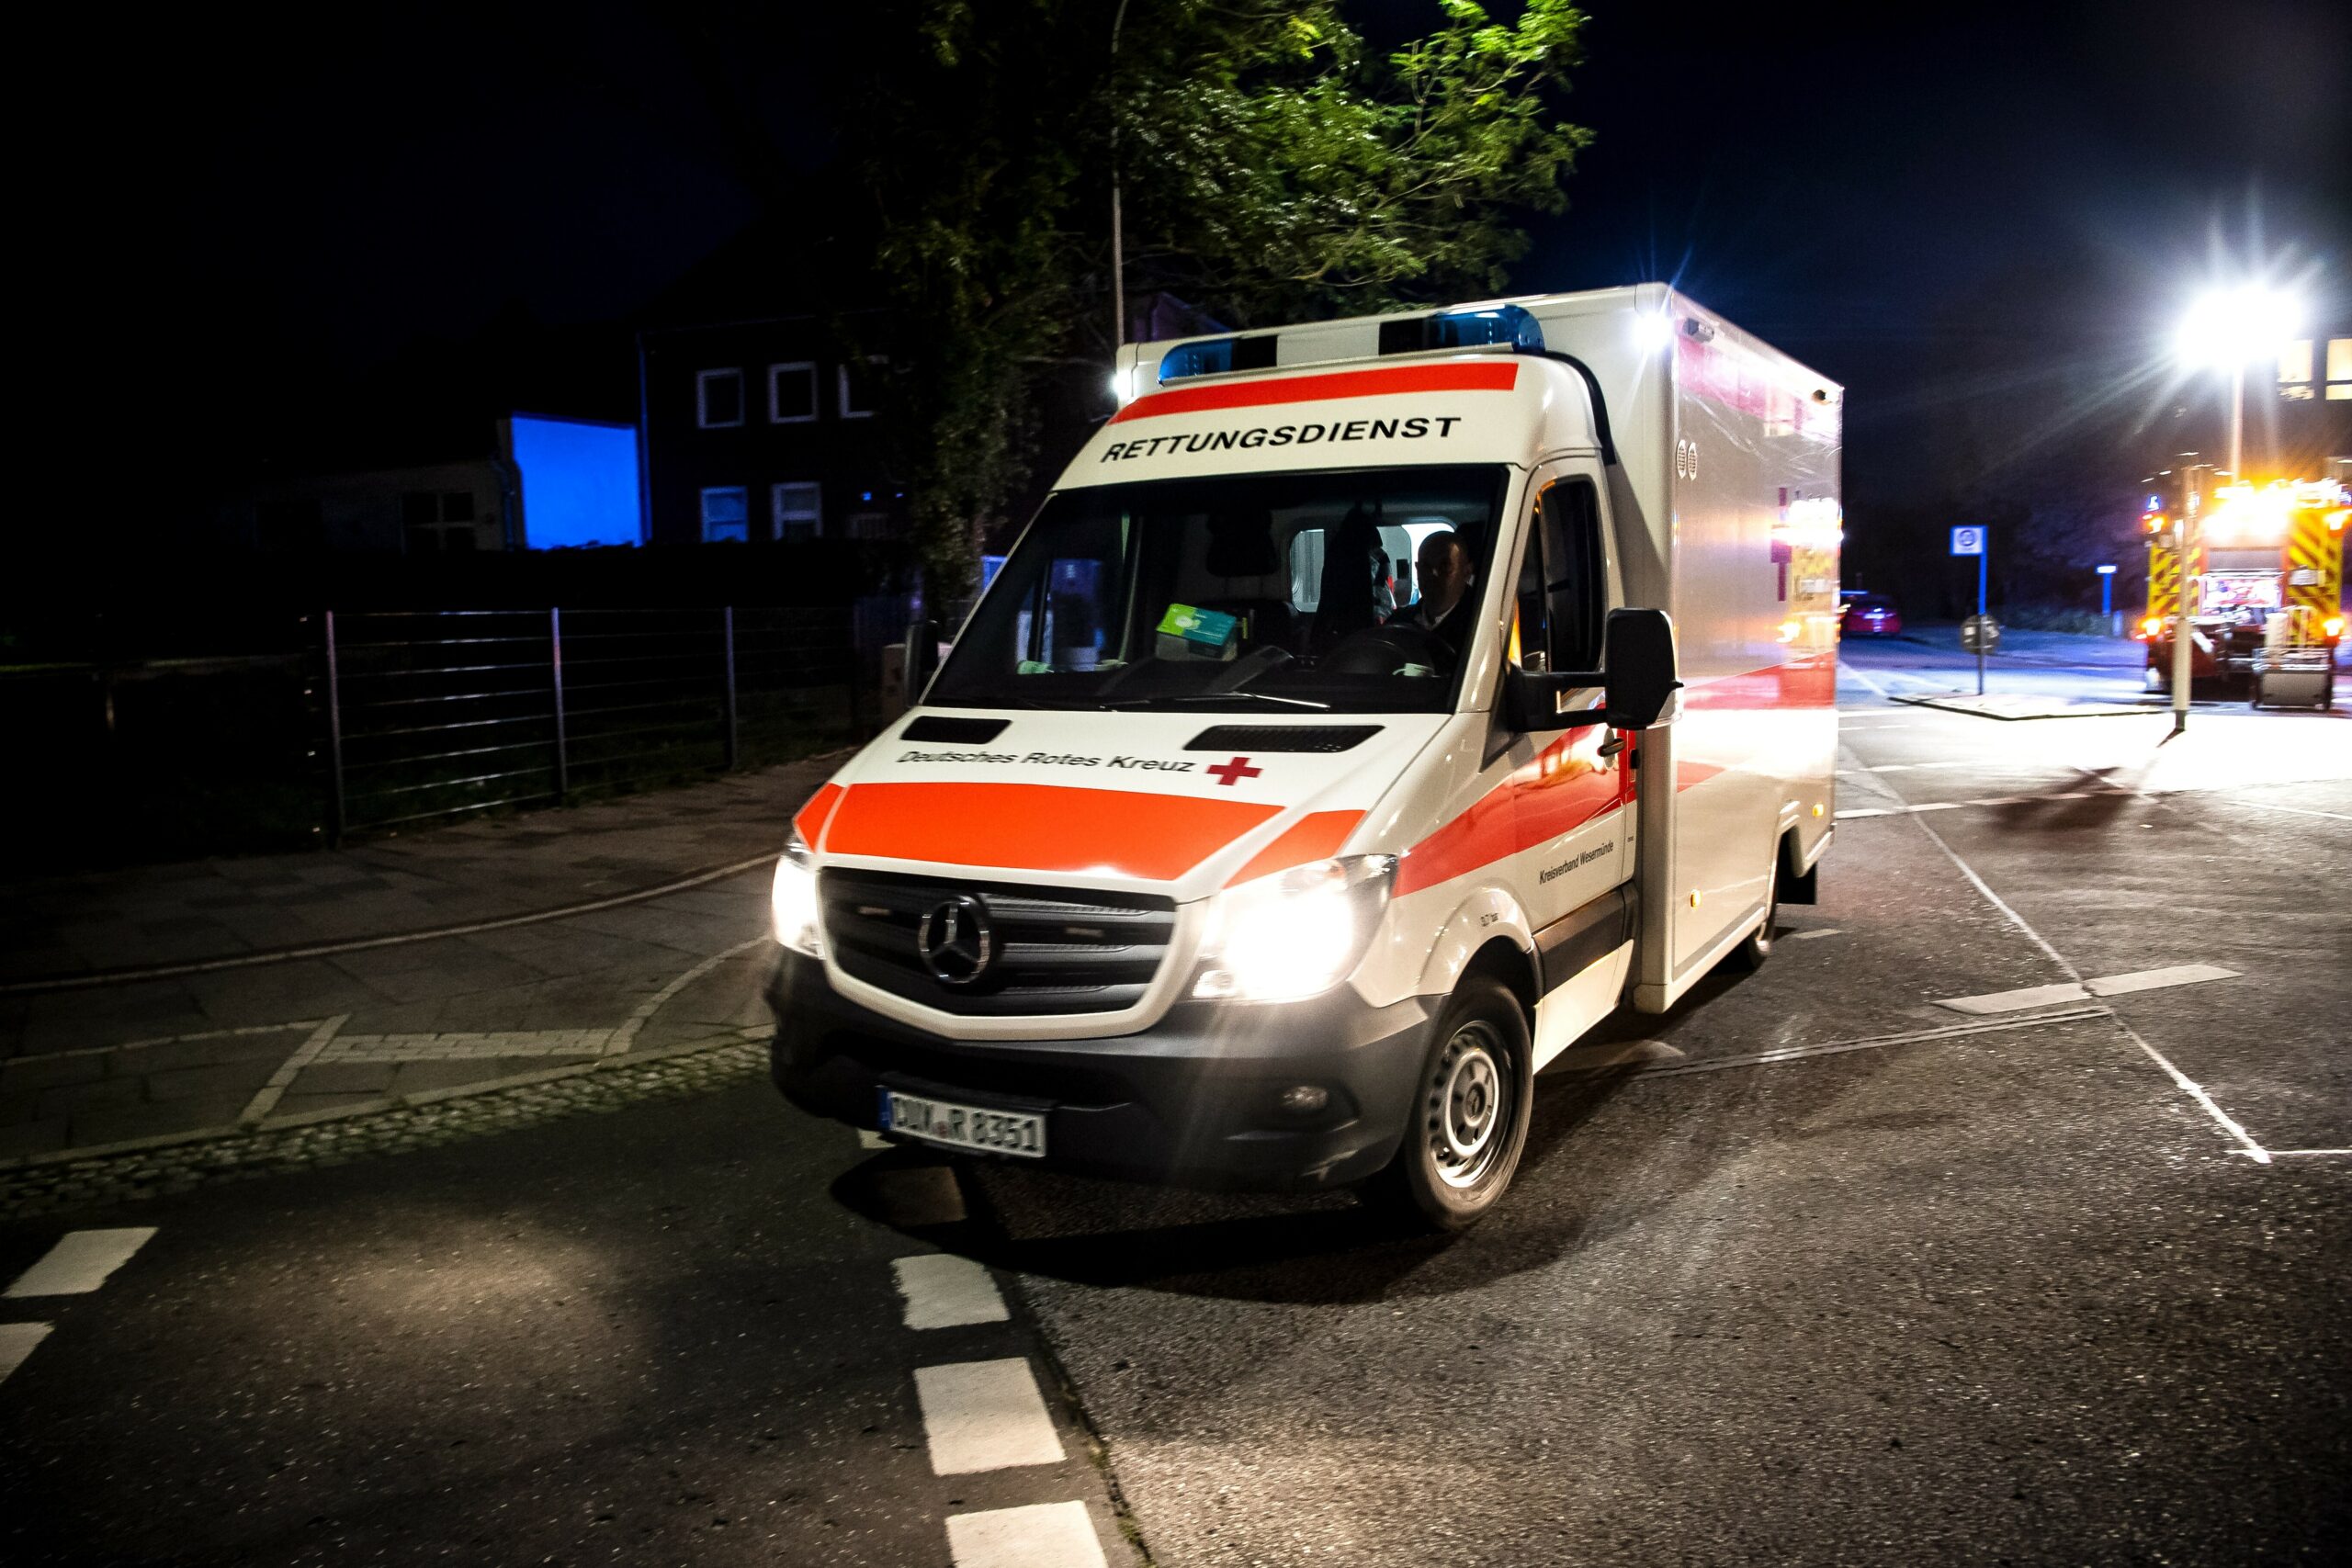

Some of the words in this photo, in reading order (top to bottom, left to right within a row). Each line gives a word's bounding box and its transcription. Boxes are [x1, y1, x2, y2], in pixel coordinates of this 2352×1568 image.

[1100, 416, 1462, 463] RETTUNGSDIENST
[896, 750, 1018, 763] Deutsches
[1020, 751, 1102, 767] Rotes
[1106, 755, 1196, 773] Kreuz
[1539, 855, 1579, 885] Kreisverband
[1579, 840, 1614, 866] Wesermünde
